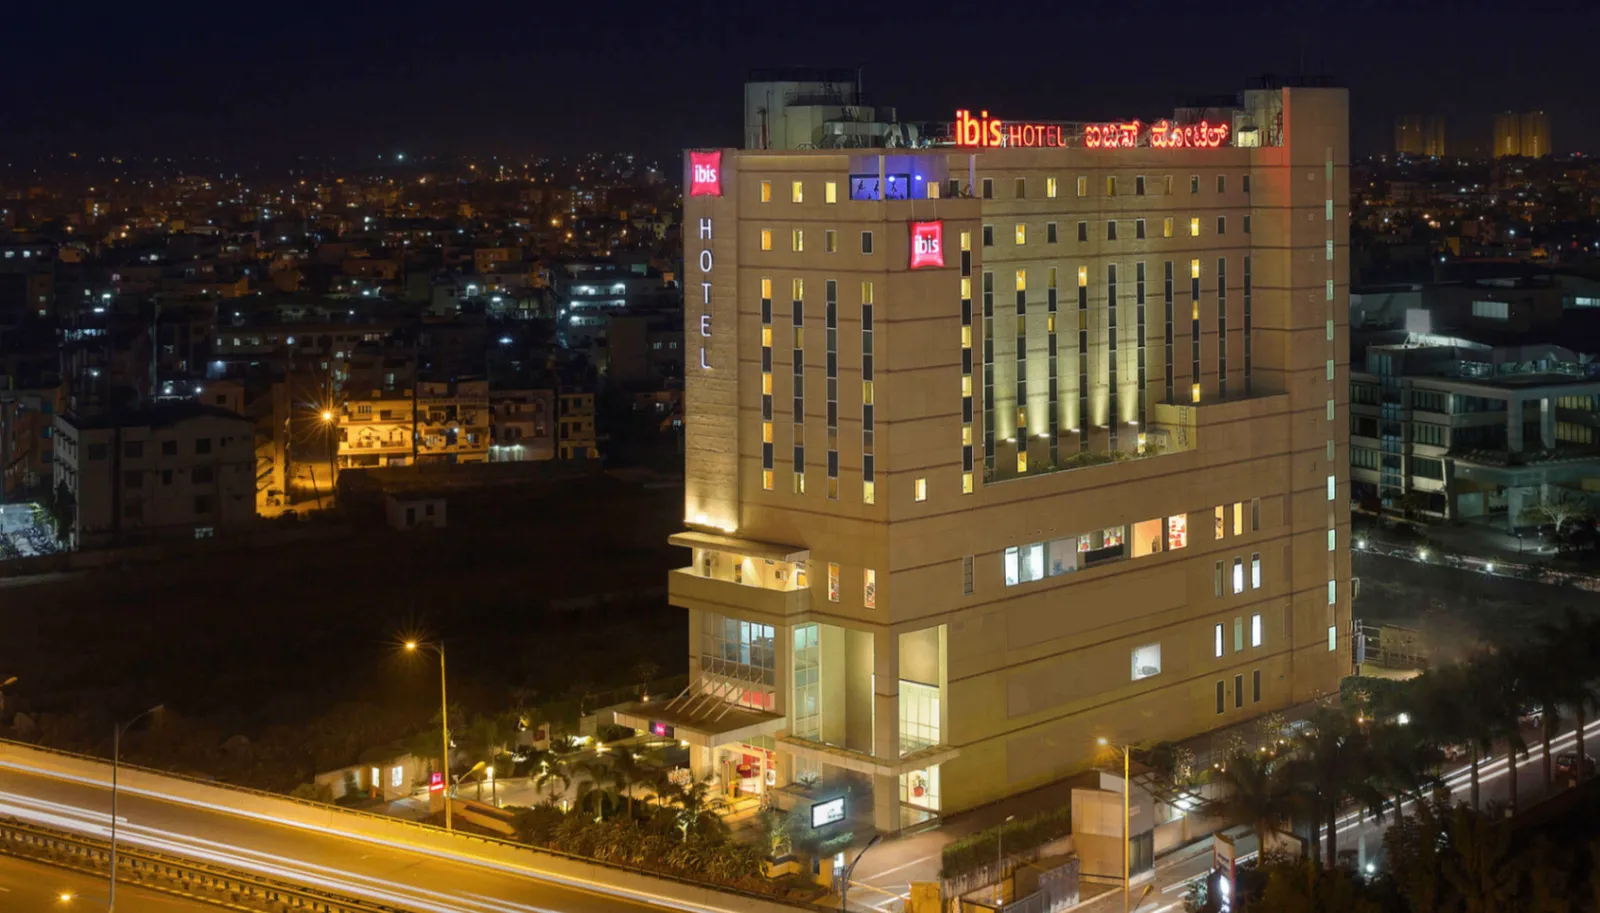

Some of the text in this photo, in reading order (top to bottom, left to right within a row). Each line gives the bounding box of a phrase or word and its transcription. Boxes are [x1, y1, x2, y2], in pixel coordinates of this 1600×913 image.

[956, 109, 1067, 147] ibis HOTEL
[694, 163, 717, 184] ibis
[914, 234, 940, 255] ibis
[699, 217, 713, 369] HOTEL
